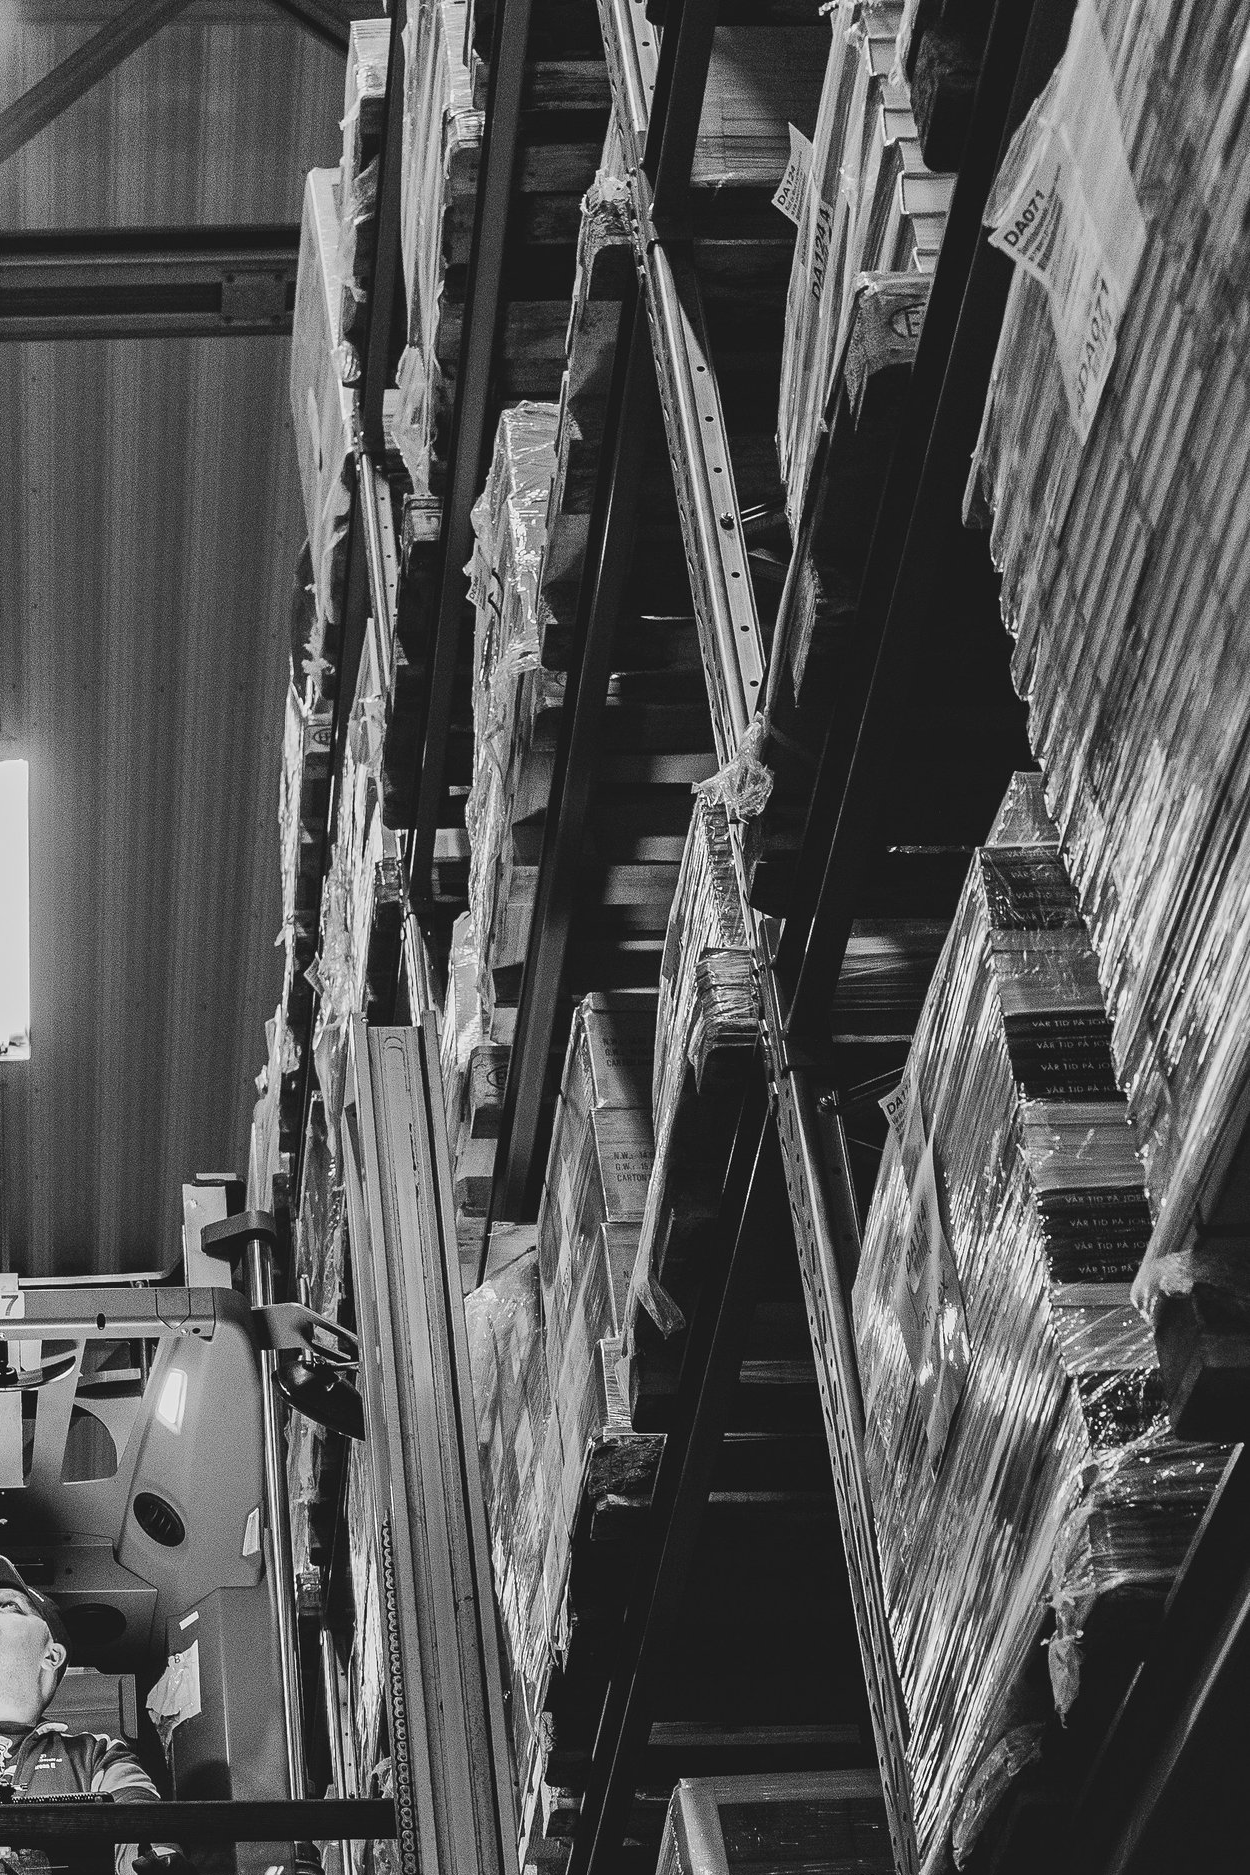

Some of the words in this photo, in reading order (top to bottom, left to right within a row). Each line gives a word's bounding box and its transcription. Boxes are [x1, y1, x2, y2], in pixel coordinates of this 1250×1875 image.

[777, 164, 796, 206] DA124
[1003, 189, 1045, 247] DA071
[1031, 1019, 1051, 1028] VÅR
[1054, 1019, 1070, 1027] TID
[1073, 1018, 1085, 1026] PÅ
[1036, 1041, 1055, 1050] VÅR
[1058, 1041, 1074, 1049] TID
[1077, 1039, 1089, 1048] PÅ
[1040, 1063, 1060, 1072] VÅR
[1063, 1062, 1078, 1070] TID
[1082, 1061, 1094, 1070] PÅ
[1045, 1085, 1066, 1094] VÅR
[1068, 1084, 1084, 1093] TID
[1087, 1083, 1100, 1092] PÅ
[1064, 1194, 1084, 1203] VÅR
[1088, 1195, 1103, 1203] TID
[1106, 1194, 1119, 1202] PÅ
[1069, 1218, 1088, 1228] VÅR
[1092, 1218, 1108, 1226] TID
[1112, 1217, 1124, 1225] PÅ
[1074, 1242, 1094, 1251] VÅR
[1097, 1242, 1113, 1250] TID
[1116, 1241, 1129, 1249] PÅ
[1078, 1265, 1098, 1275] VÅR
[1102, 1265, 1117, 1274] TID
[1121, 1264, 1134, 1272] PÅ
